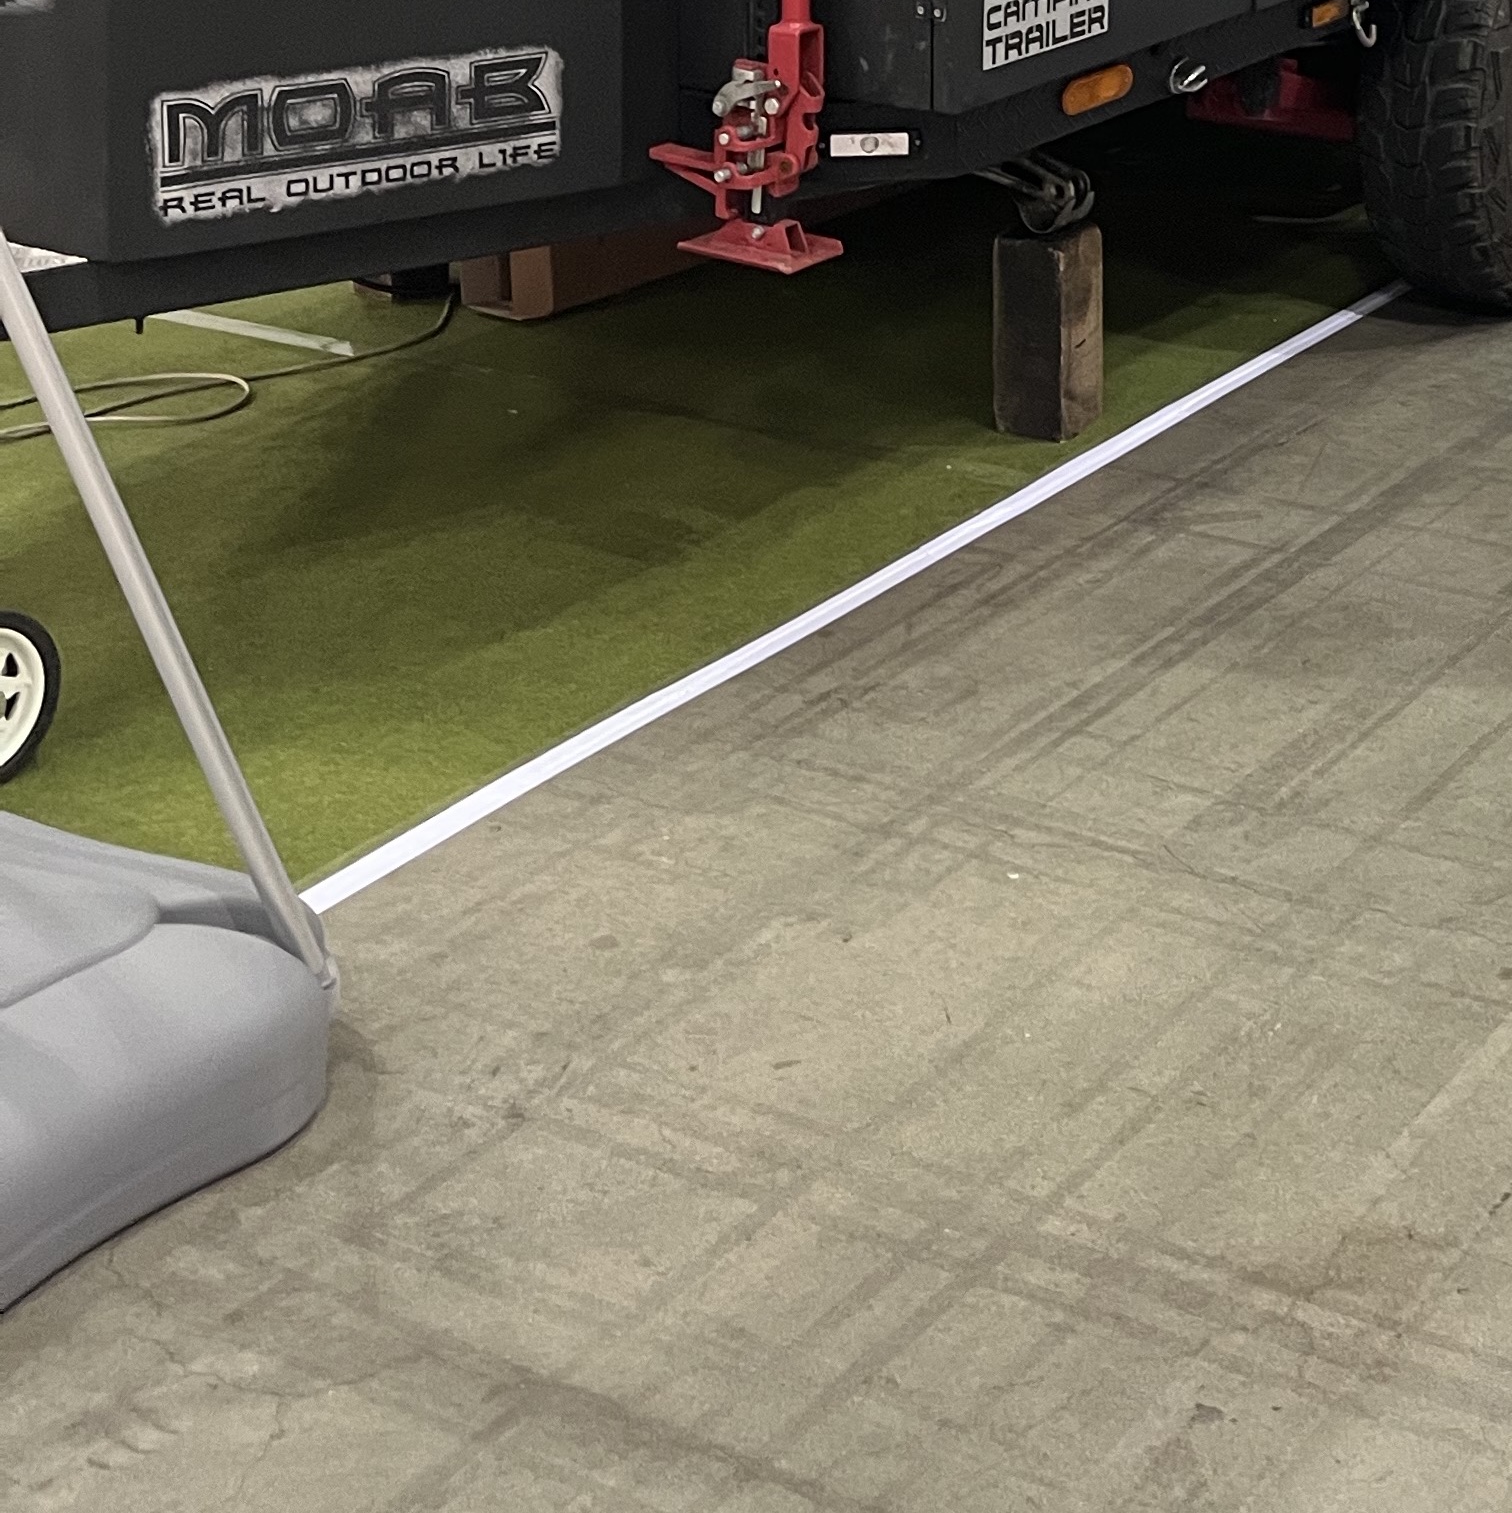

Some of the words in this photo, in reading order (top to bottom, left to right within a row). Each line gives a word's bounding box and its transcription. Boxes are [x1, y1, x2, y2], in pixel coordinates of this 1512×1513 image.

[985, 4, 1105, 65] TRAILER
[161, 51, 552, 169] MOAB
[159, 186, 266, 217] REAL
[286, 156, 460, 197] OUTDOOR
[478, 141, 558, 169] LIFE
